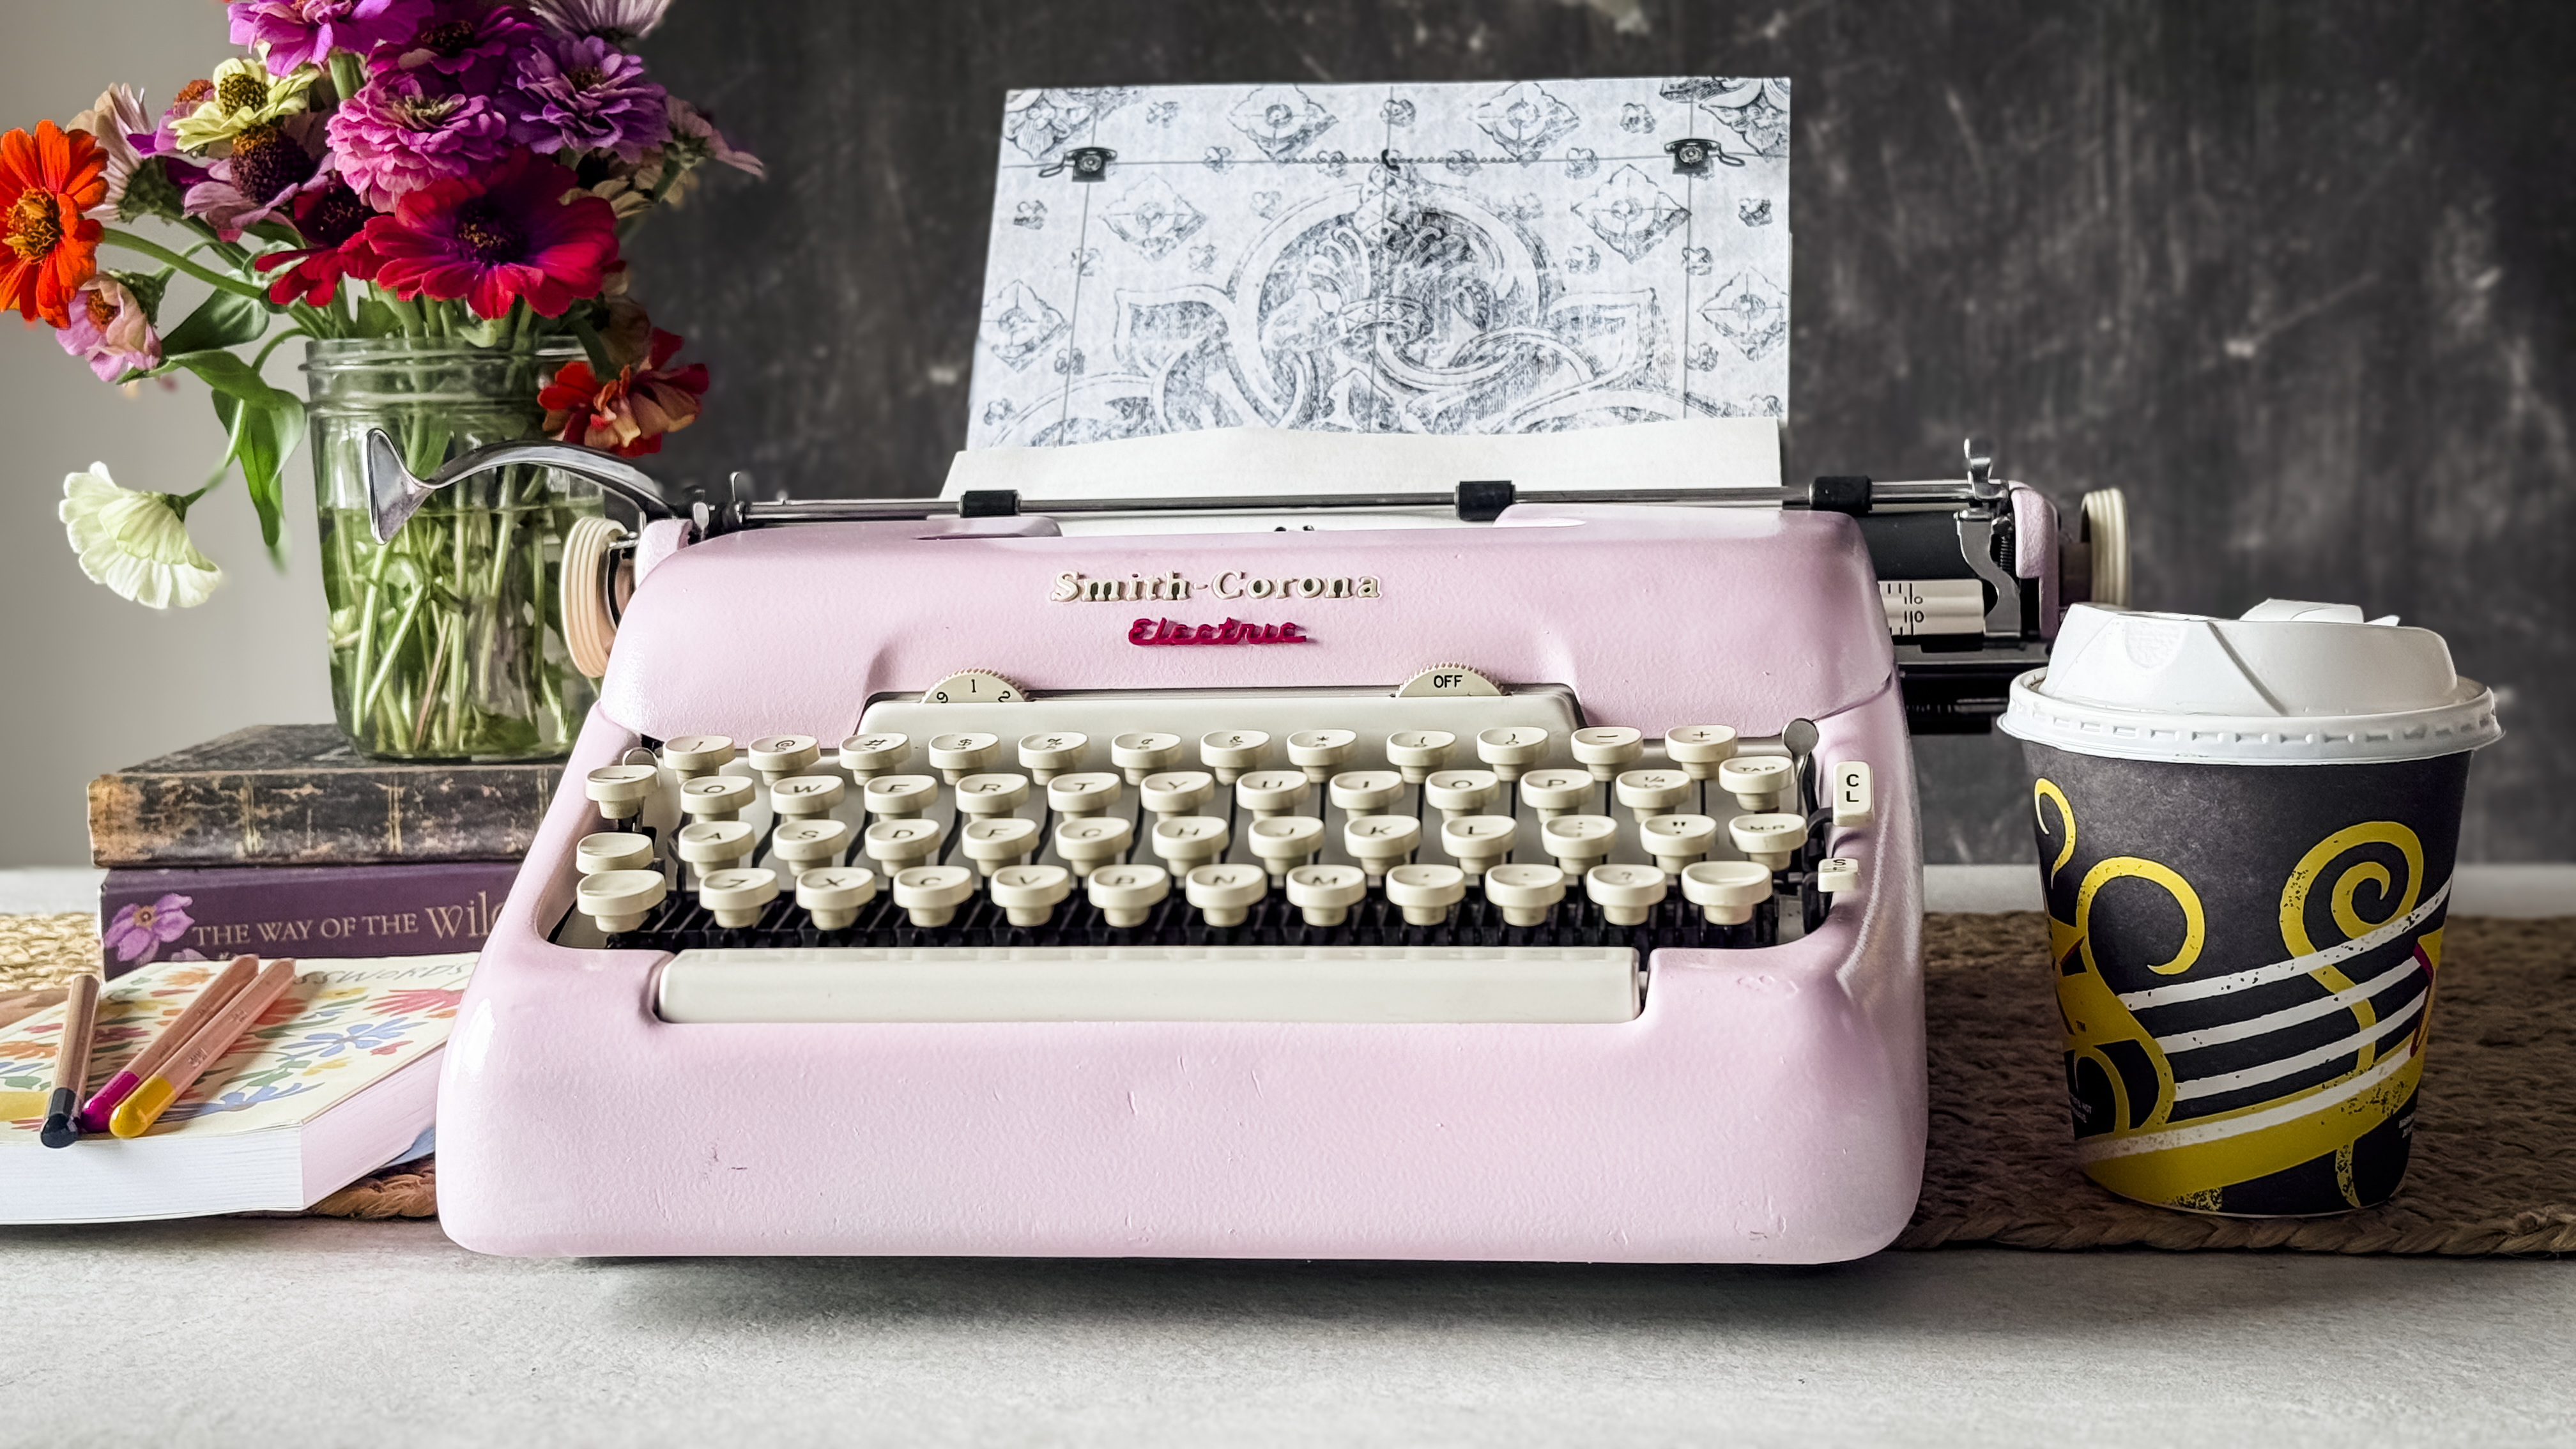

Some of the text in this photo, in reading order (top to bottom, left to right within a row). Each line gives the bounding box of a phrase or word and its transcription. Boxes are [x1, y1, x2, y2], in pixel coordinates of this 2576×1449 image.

[1051, 570, 1383, 602] Smith-Corona
[1128, 617, 1307, 645] Electric
[970, 678, 977, 693] 1
[1433, 675, 1463, 689] OFF
[794, 785, 822, 793] W
[886, 784, 910, 793] E
[978, 784, 1001, 792] R
[1073, 782, 1095, 791] T
[1167, 780, 1188, 790] Y
[1452, 779, 1473, 789] O
[1547, 779, 1567, 787] P
[702, 832, 722, 840] A
[797, 831, 820, 839] S
[891, 830, 914, 839] D
[987, 828, 1010, 838] F
[1178, 828, 1200, 836] H
[1370, 826, 1393, 835] K
[820, 878, 847, 887] X
[920, 877, 942, 887] C
[1019, 876, 1041, 885] V
[1114, 875, 1136, 885] B
[1214, 875, 1236, 886] N
[1312, 876, 1338, 886] M
[192, 924, 251, 946] THE
[256, 920, 313, 942] WAY
[321, 916, 357, 939] OF
[362, 913, 419, 936] THE
